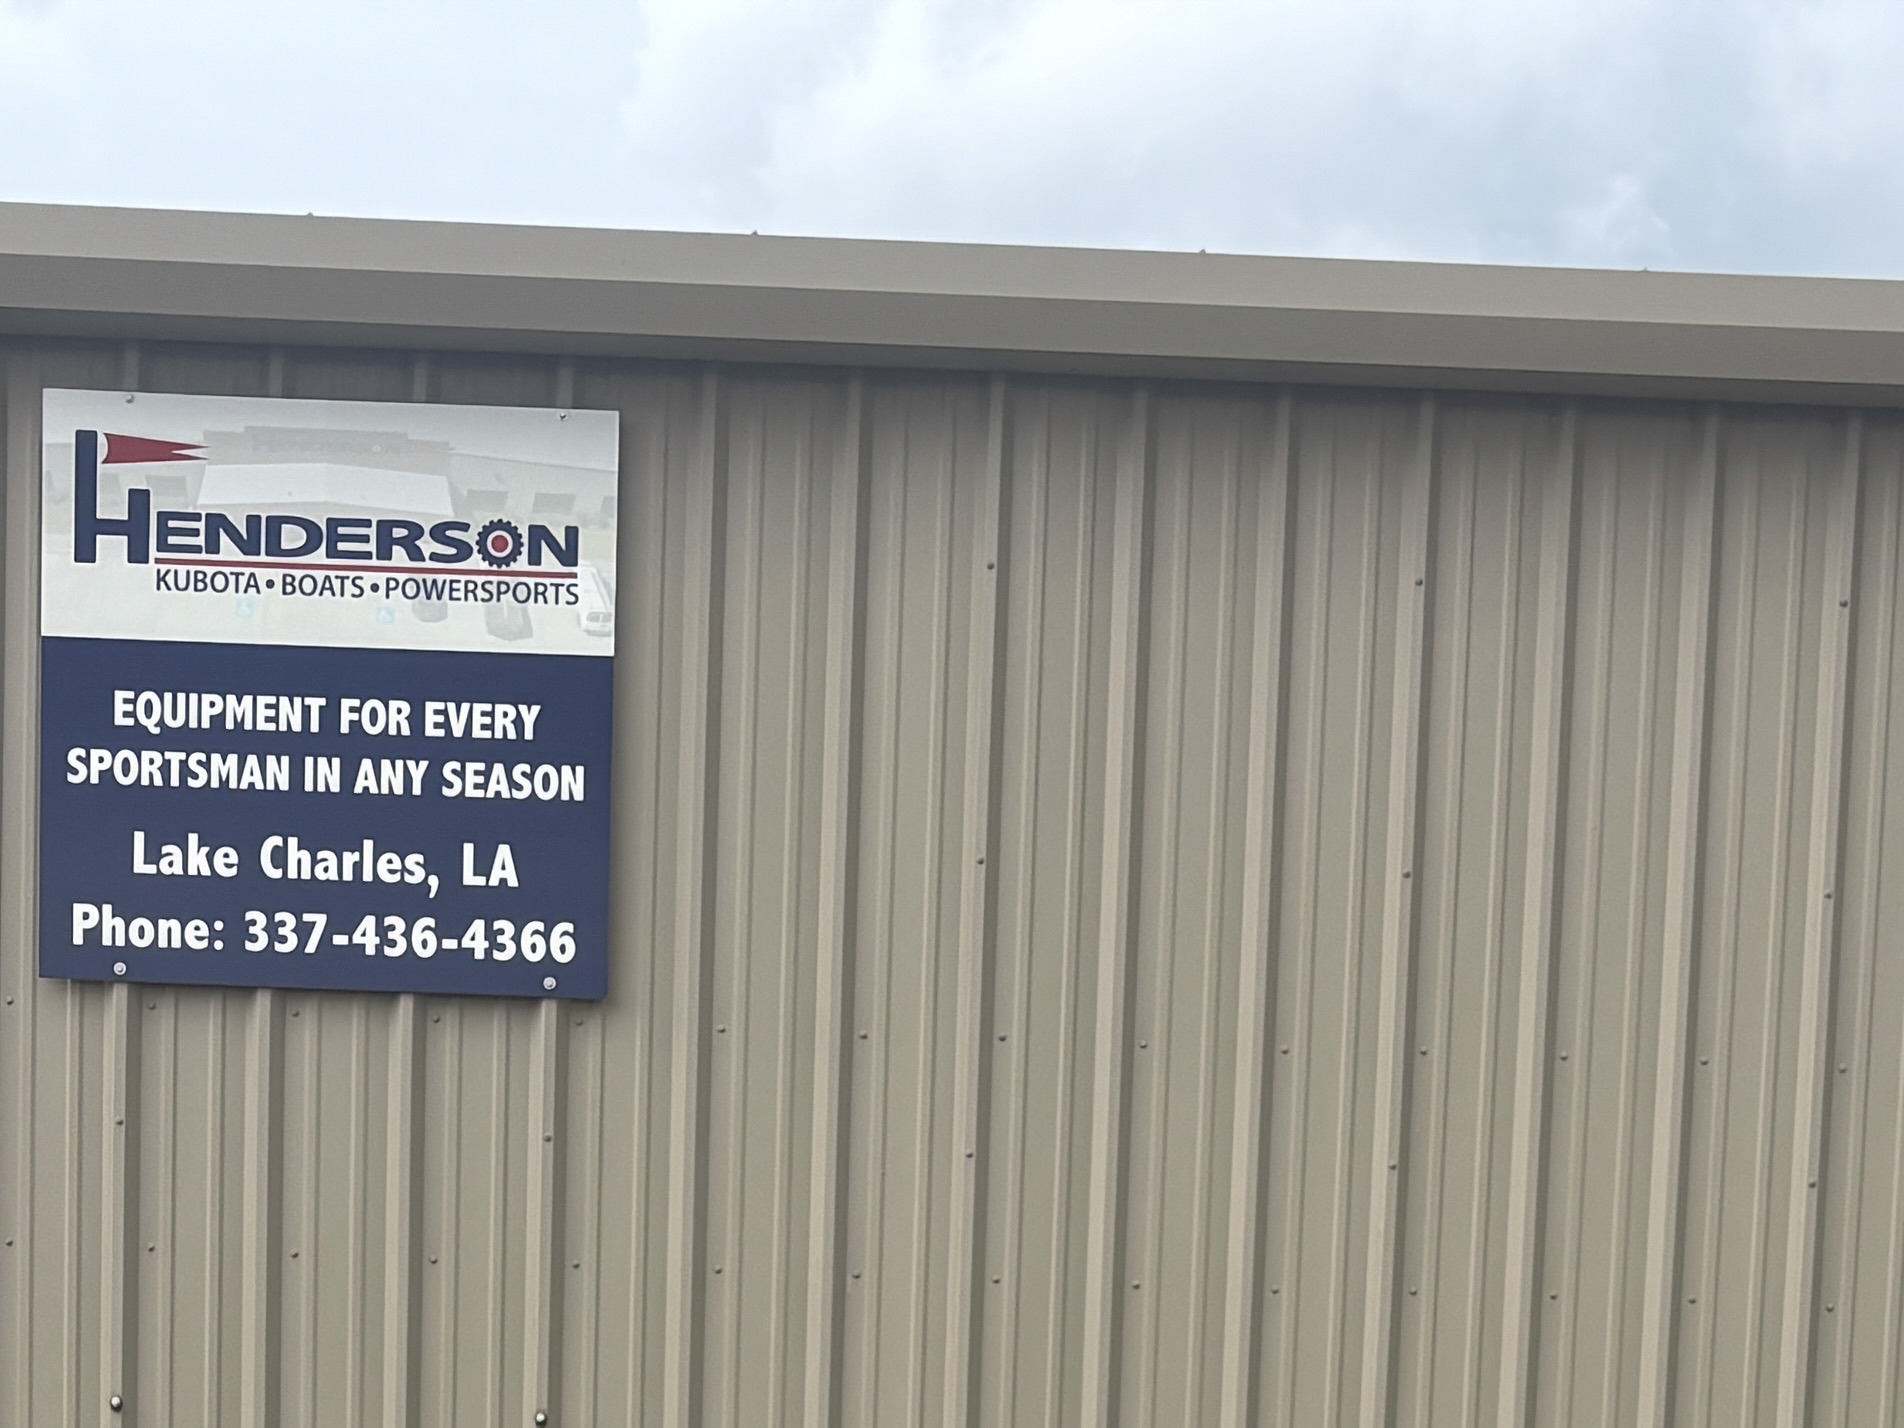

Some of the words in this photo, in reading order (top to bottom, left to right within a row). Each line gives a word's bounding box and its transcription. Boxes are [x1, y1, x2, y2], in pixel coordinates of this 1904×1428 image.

[73, 430, 579, 569] HENDERSON
[115, 690, 326, 734] EQUIPMENT
[340, 699, 410, 735] FOR
[425, 702, 541, 740] EVERY
[67, 748, 289, 790] SPORTSMAN
[305, 757, 340, 792] IN
[354, 759, 429, 795] ANY
[442, 761, 584, 801] SEASON
[134, 831, 238, 877] Lake
[261, 836, 438, 898] Charles,
[463, 843, 518, 887] LA
[73, 903, 223, 950] Phone:
[245, 911, 575, 963] 337-436-4366
